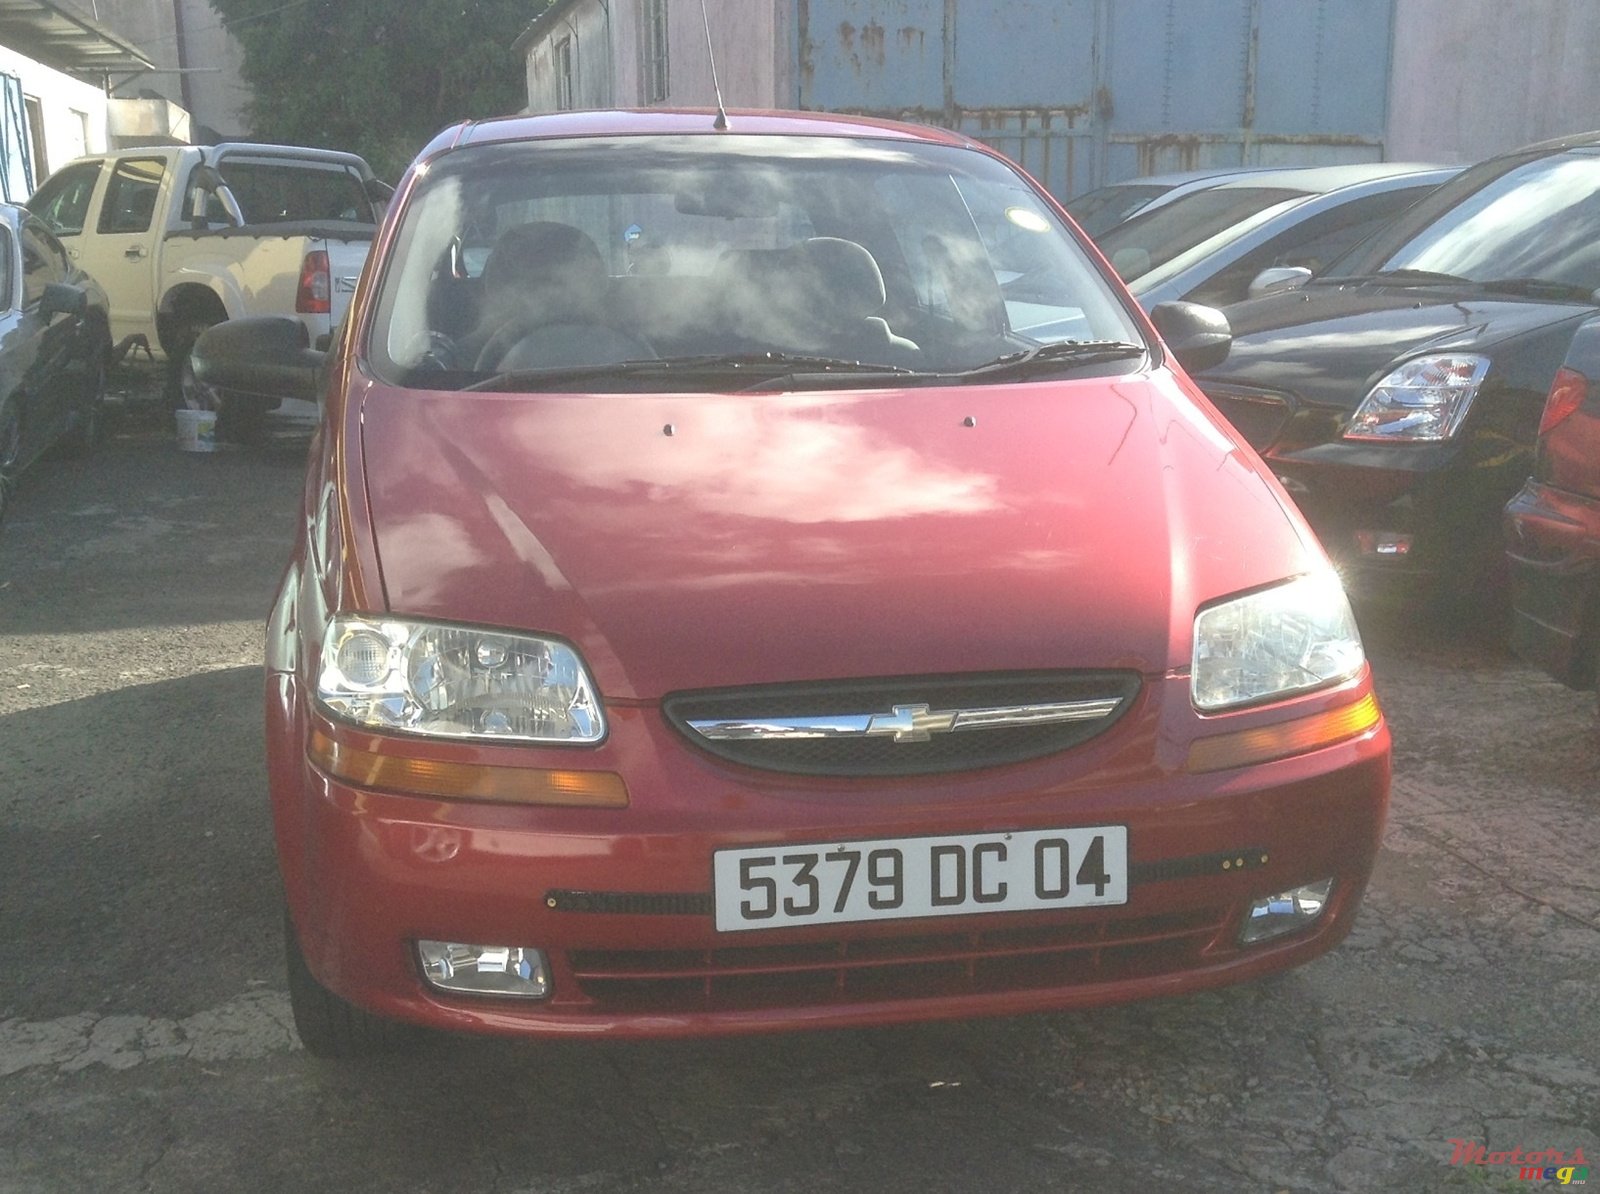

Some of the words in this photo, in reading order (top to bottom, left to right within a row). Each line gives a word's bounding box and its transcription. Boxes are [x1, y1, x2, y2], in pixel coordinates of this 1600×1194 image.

[739, 847, 904, 921] 5379
[930, 842, 1008, 907] DC
[1034, 835, 1111, 900] 04
